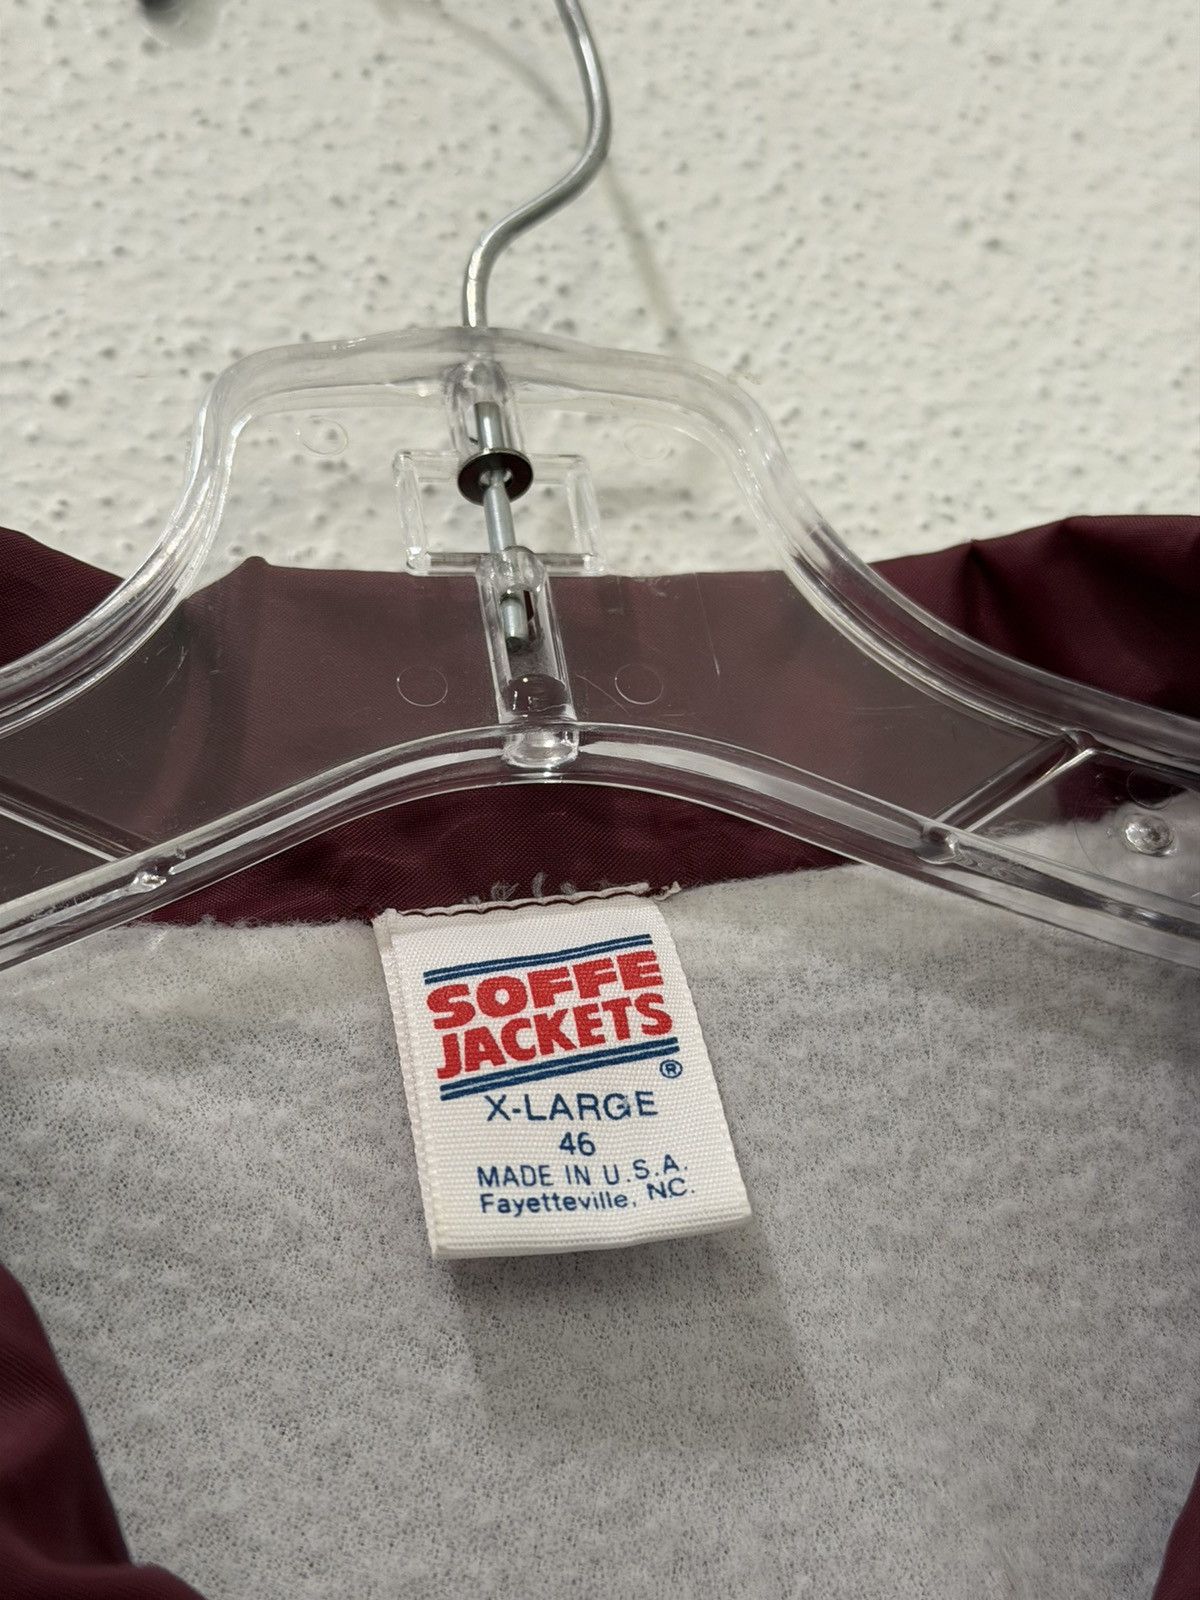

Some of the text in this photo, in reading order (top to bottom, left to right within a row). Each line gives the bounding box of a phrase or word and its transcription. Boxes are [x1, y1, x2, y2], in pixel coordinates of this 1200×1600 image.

[427, 950, 664, 1030] SOFFE
[437, 993, 673, 1080] JACKETS
[484, 1091, 659, 1122] X-LARGE
[559, 1132, 596, 1157] 46
[477, 1153, 688, 1188] MADE IN U.S.A.
[481, 1191, 638, 1217] Fayetteville,
